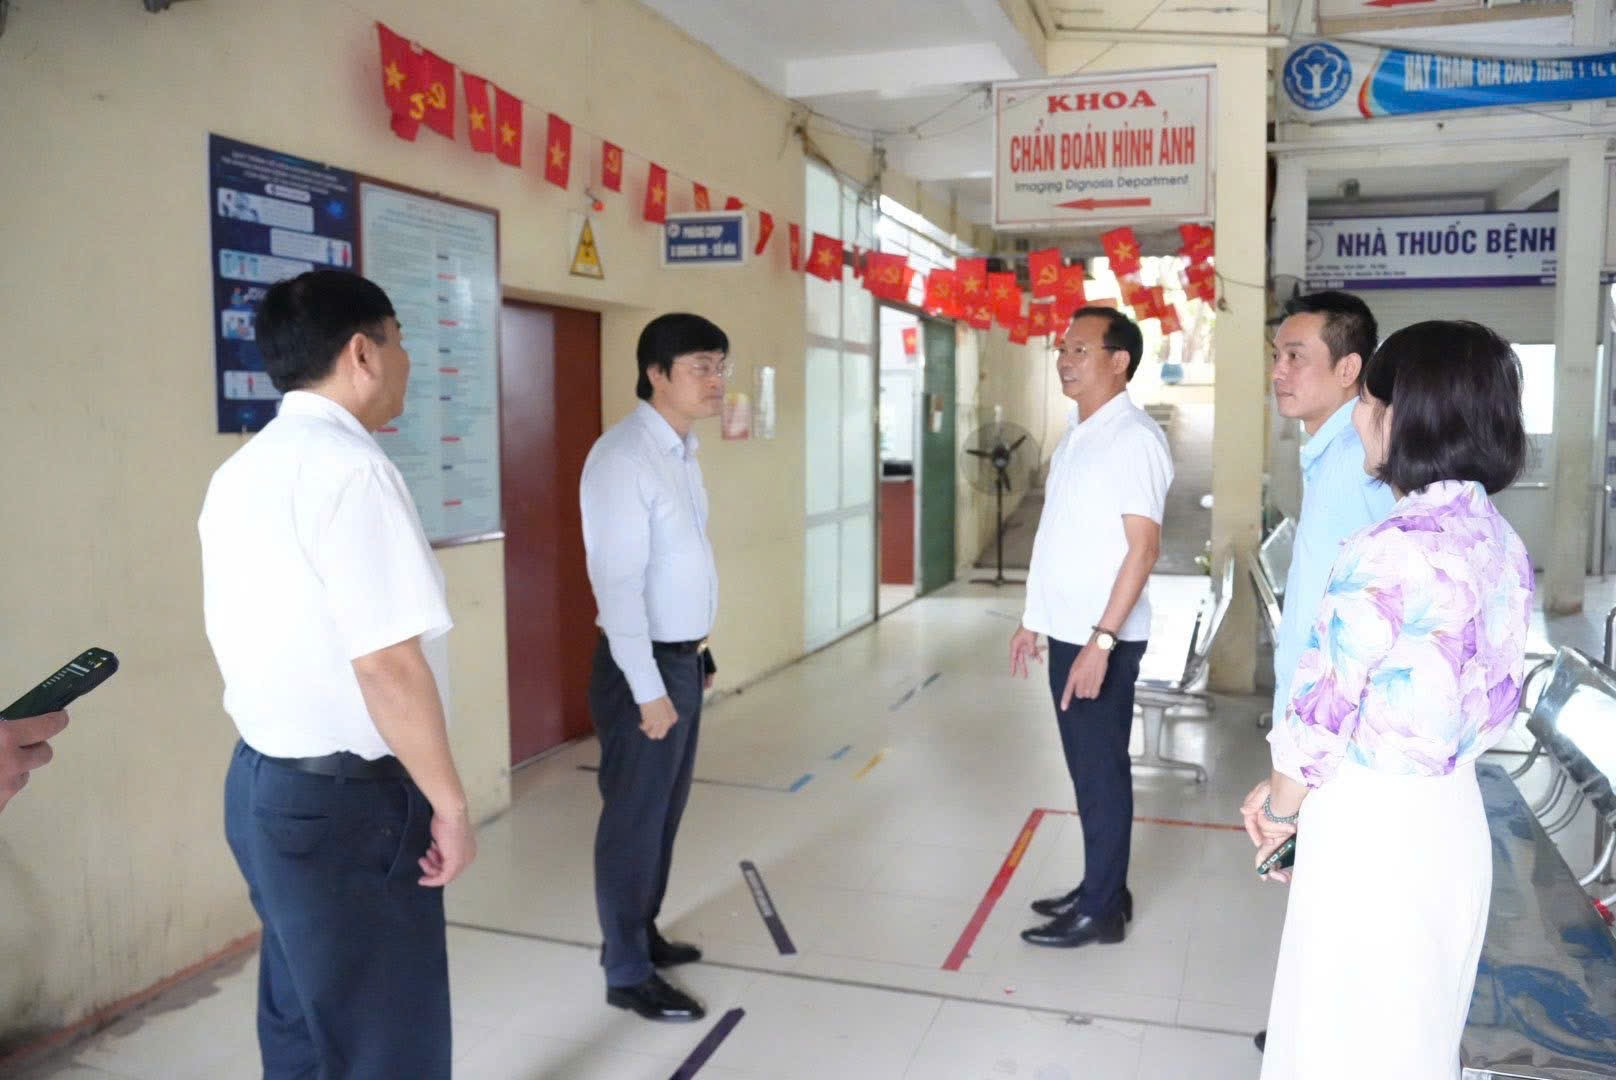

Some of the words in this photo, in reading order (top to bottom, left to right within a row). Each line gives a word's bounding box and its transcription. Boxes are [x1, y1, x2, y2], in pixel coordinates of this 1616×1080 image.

[1047, 89, 1156, 113] KHOA
[1010, 118, 1056, 173] CHẨN
[1061, 123, 1107, 170] ĐOÁN
[1112, 121, 1153, 168] HÌNH
[1159, 110, 1196, 166] ẢNH
[1014, 180, 1063, 194] Imaging
[1065, 178, 1114, 192] Dignosis
[1116, 174, 1189, 188] Department
[1336, 227, 1388, 257] NHÀ
[1395, 220, 1477, 257] THUỐC
[1485, 222, 1556, 260] BỆNH
